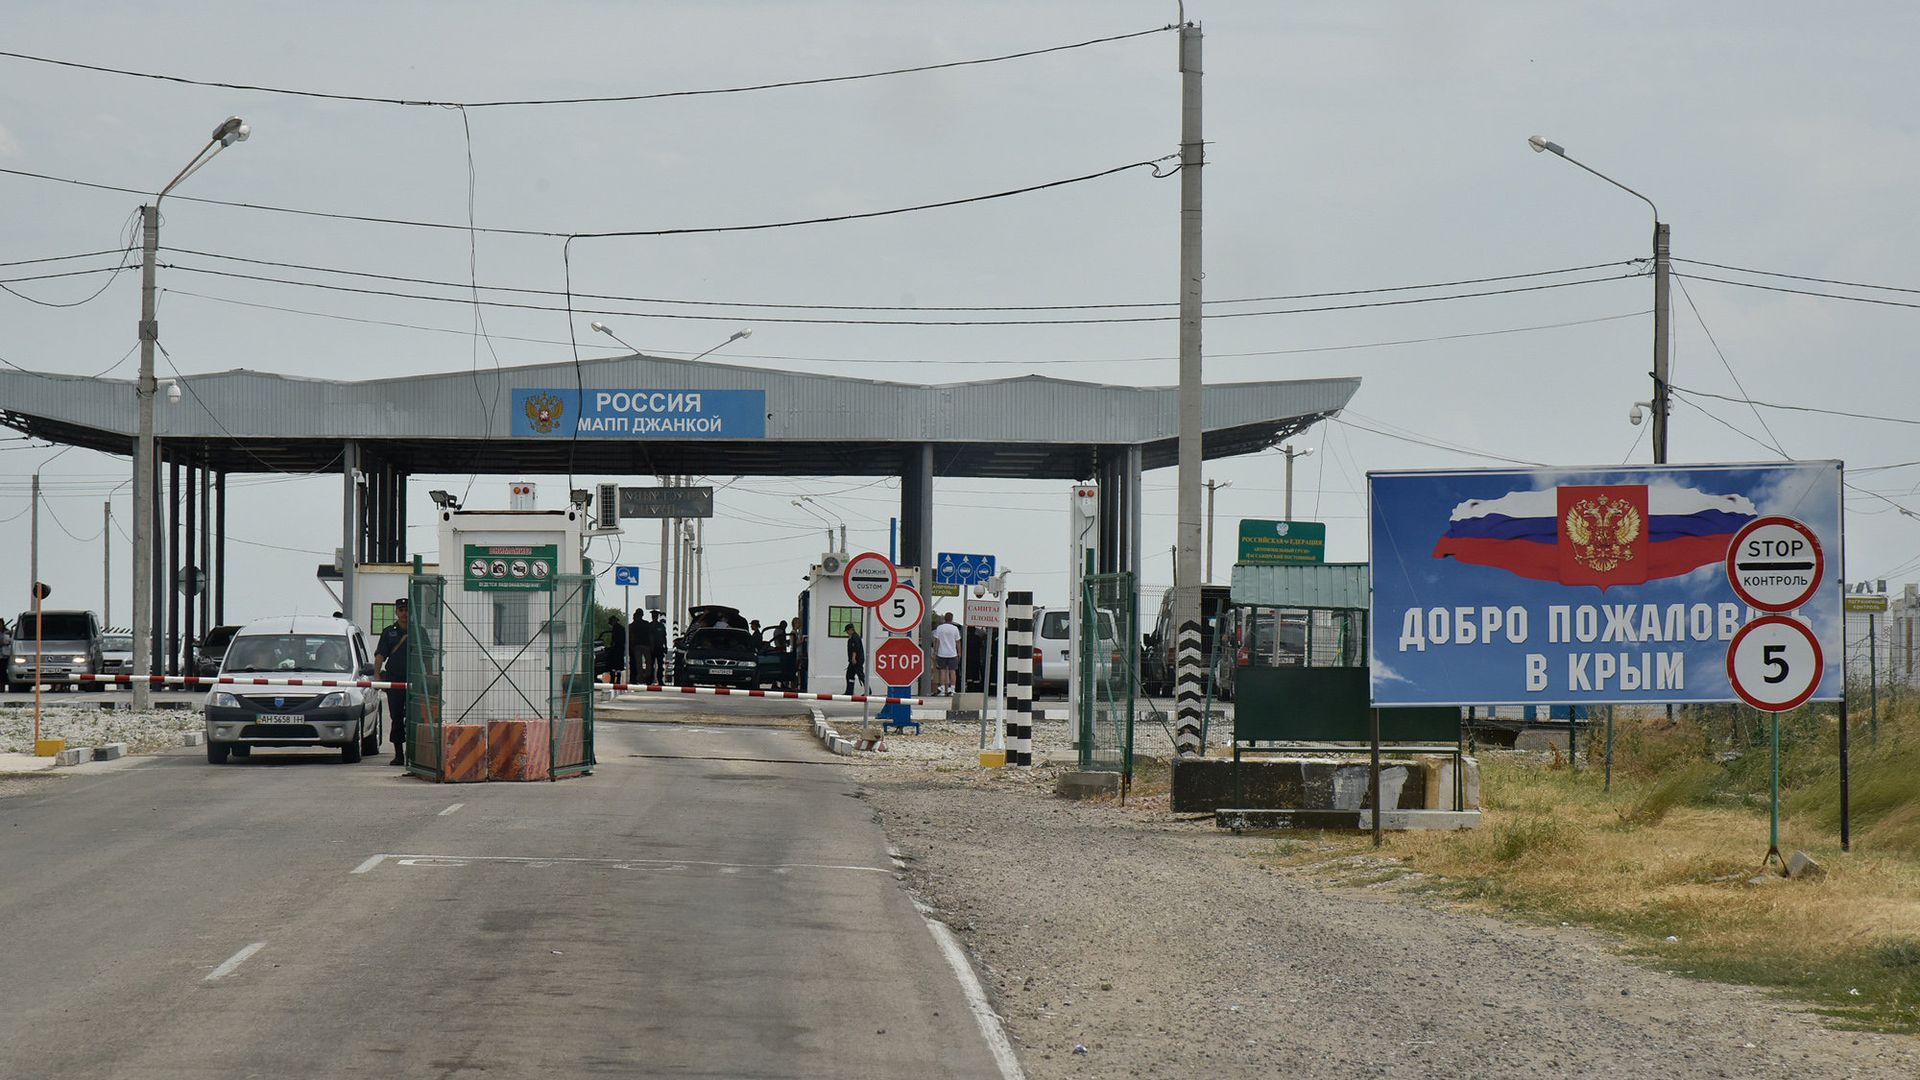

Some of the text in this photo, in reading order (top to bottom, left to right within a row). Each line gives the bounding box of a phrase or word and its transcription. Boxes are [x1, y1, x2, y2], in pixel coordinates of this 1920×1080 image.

[596, 392, 701, 413] РОССИЯ
[578, 414, 722, 434] МАПП ДЖАНКОЙ
[1241, 536, 1284, 545] РОССИЙСКАЯ
[1748, 540, 1804, 557] STOP
[1743, 575, 1808, 586] КОНТРОЛЬ
[893, 599, 906, 618] 5
[1399, 602, 1812, 651] ДОБРО ПОЖАЛОВ
[878, 654, 920, 670] STOP
[1526, 652, 1684, 691] В КРЫМ
[1763, 645, 1790, 684] 5
[261, 715, 273, 724] AH
[273, 715, 290, 724] 5658
